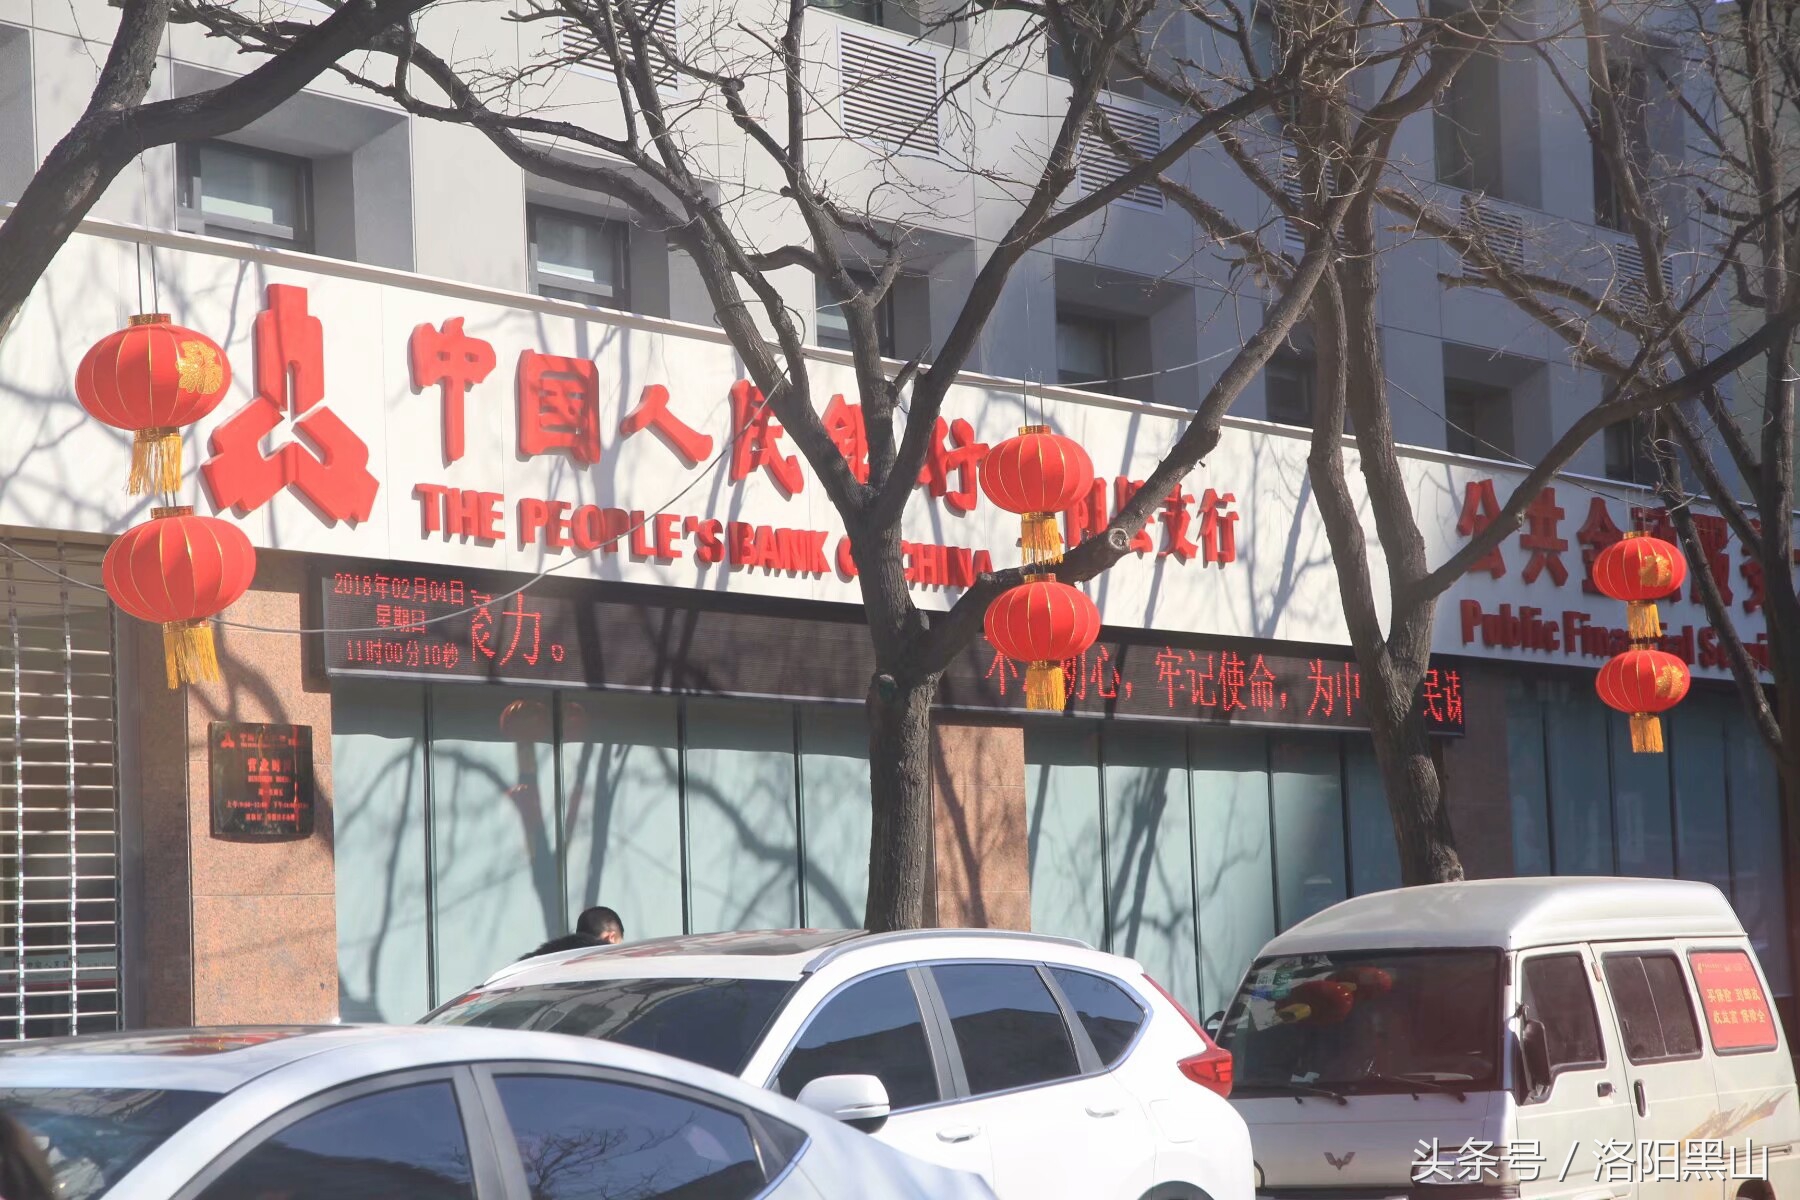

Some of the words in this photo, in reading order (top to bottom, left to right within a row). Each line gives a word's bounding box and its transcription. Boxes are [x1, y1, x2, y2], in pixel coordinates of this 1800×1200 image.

[412, 482, 505, 541] THE
[517, 497, 726, 563] PEOPLE'S
[728, 521, 831, 573] BANK
[334, 573, 465, 607] 2018年02月04日
[376, 603, 427, 633] 星期日
[1460, 599, 1560, 648] Public
[346, 638, 460, 669] 11时00分10秒
